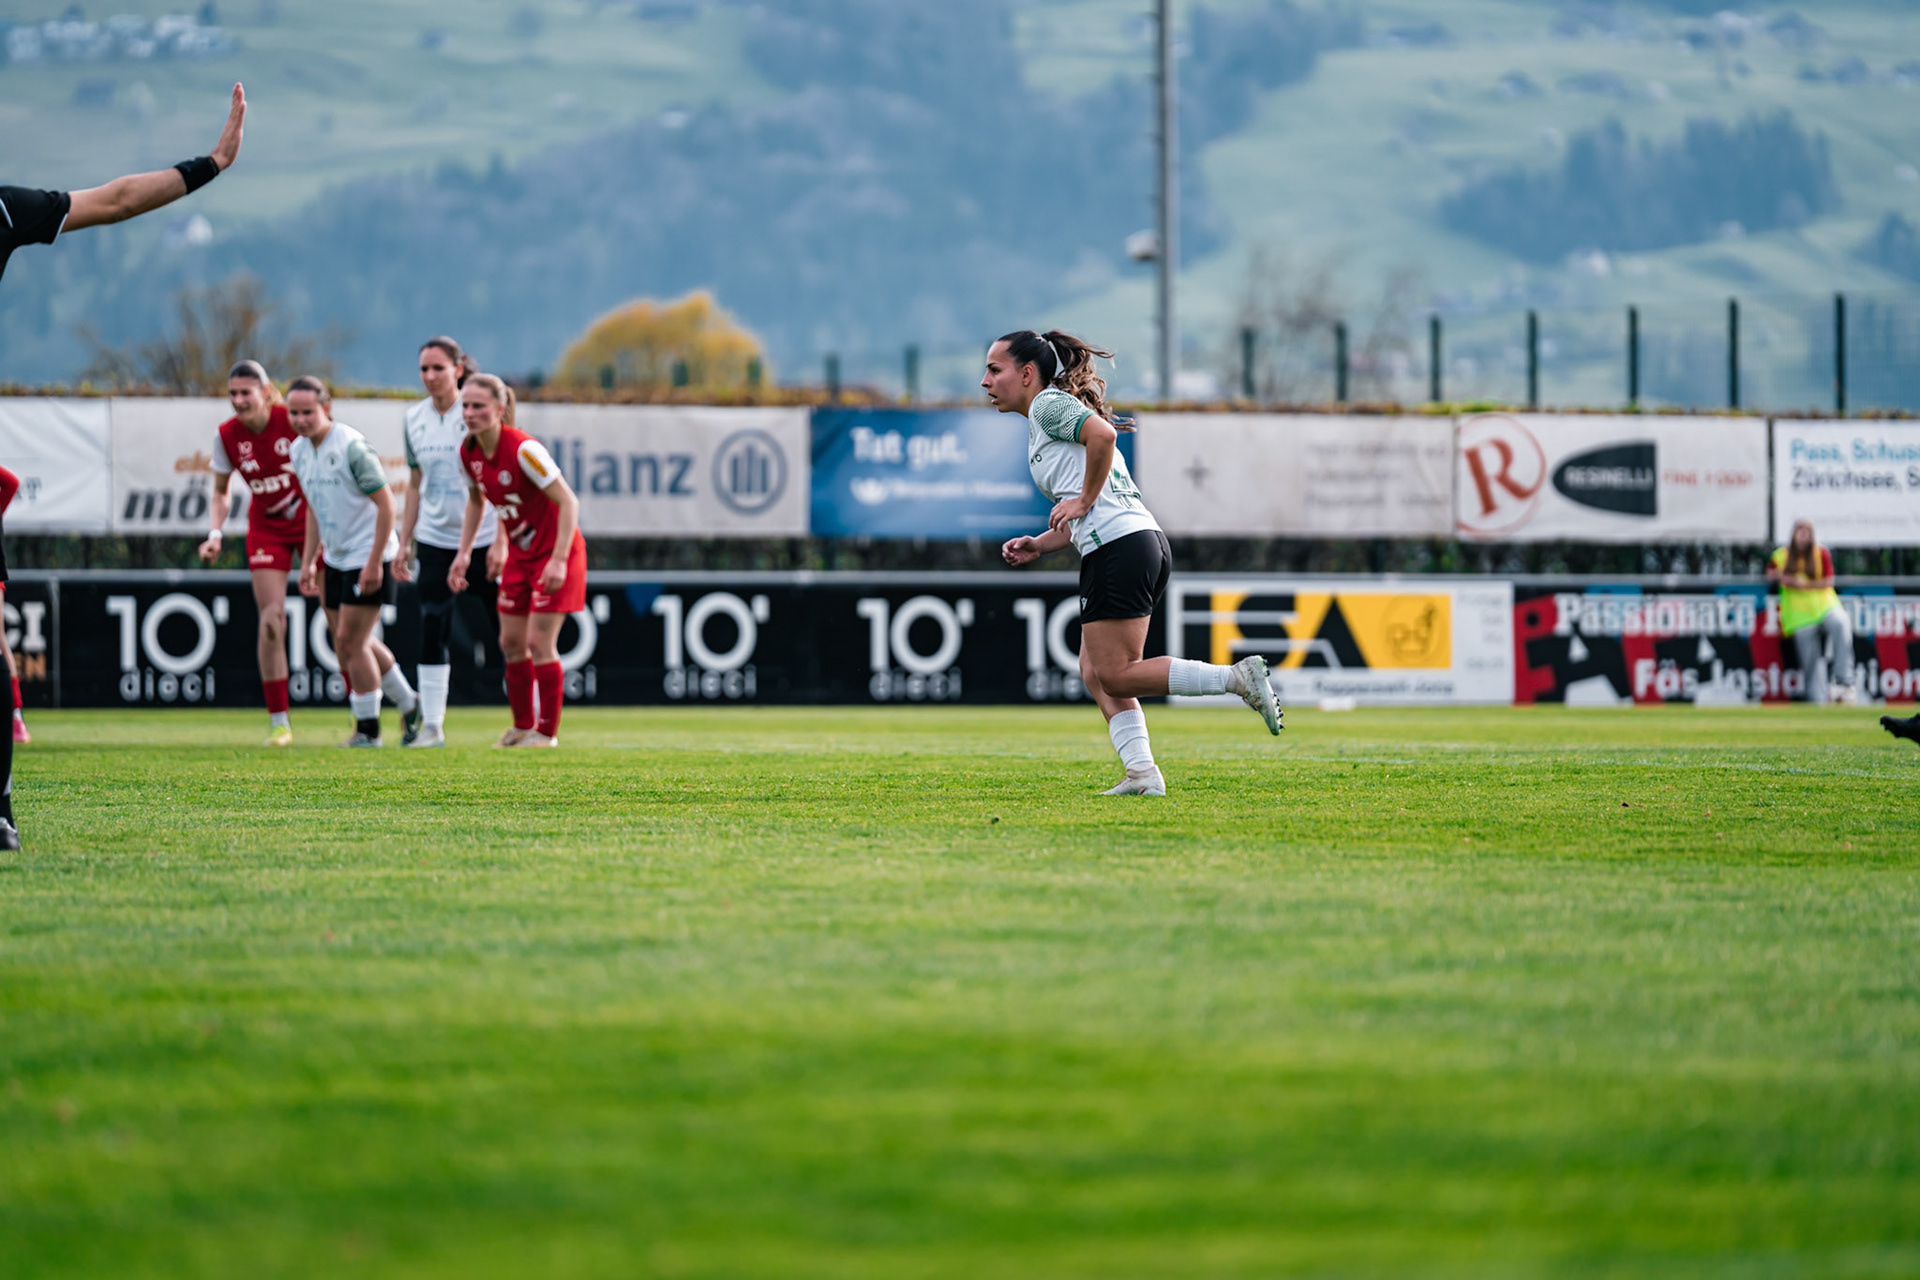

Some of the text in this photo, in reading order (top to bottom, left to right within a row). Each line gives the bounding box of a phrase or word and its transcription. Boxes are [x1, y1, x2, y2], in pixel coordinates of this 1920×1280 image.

[1463, 437, 1538, 517] R
[1554, 594, 1758, 637] Passionate
[1635, 657, 1700, 699] Fäs
